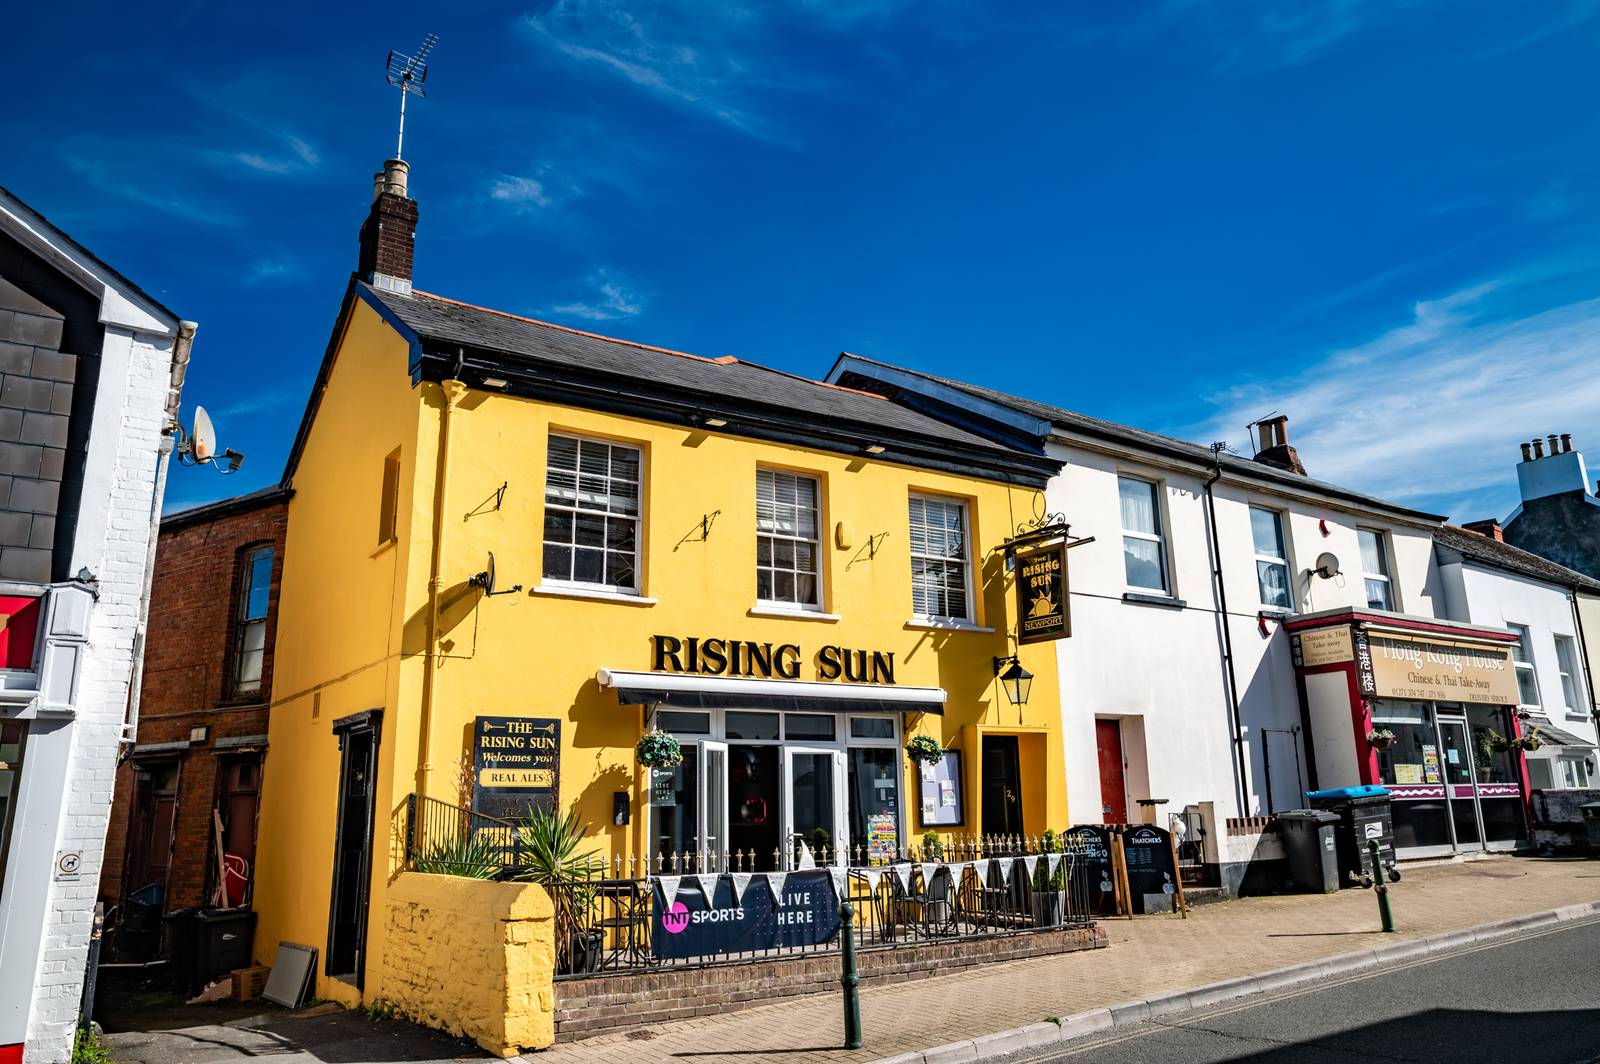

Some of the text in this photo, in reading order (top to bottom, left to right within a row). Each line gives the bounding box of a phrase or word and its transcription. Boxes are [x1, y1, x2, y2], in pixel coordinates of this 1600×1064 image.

[1022, 560, 1060, 577] RISING
[1031, 573, 1052, 588] SUN
[1025, 616, 1063, 629] NEWPORT
[651, 634, 896, 685] RISING SUN
[1383, 637, 1505, 673] Hong Kong House
[1407, 671, 1491, 692] Chinese & Thai Take-Away
[506, 721, 533, 734] THE
[481, 736, 556, 749] RISING SUN
[482, 752, 553, 766] Welcomes you
[491, 773, 544, 782] REAL ALES
[1006, 789, 1016, 803] 29
[1131, 836, 1162, 845] THATCHERS
[778, 892, 811, 906] LIVE
[663, 907, 745, 925] TNT SPORTS
[777, 910, 814, 925] HERE
